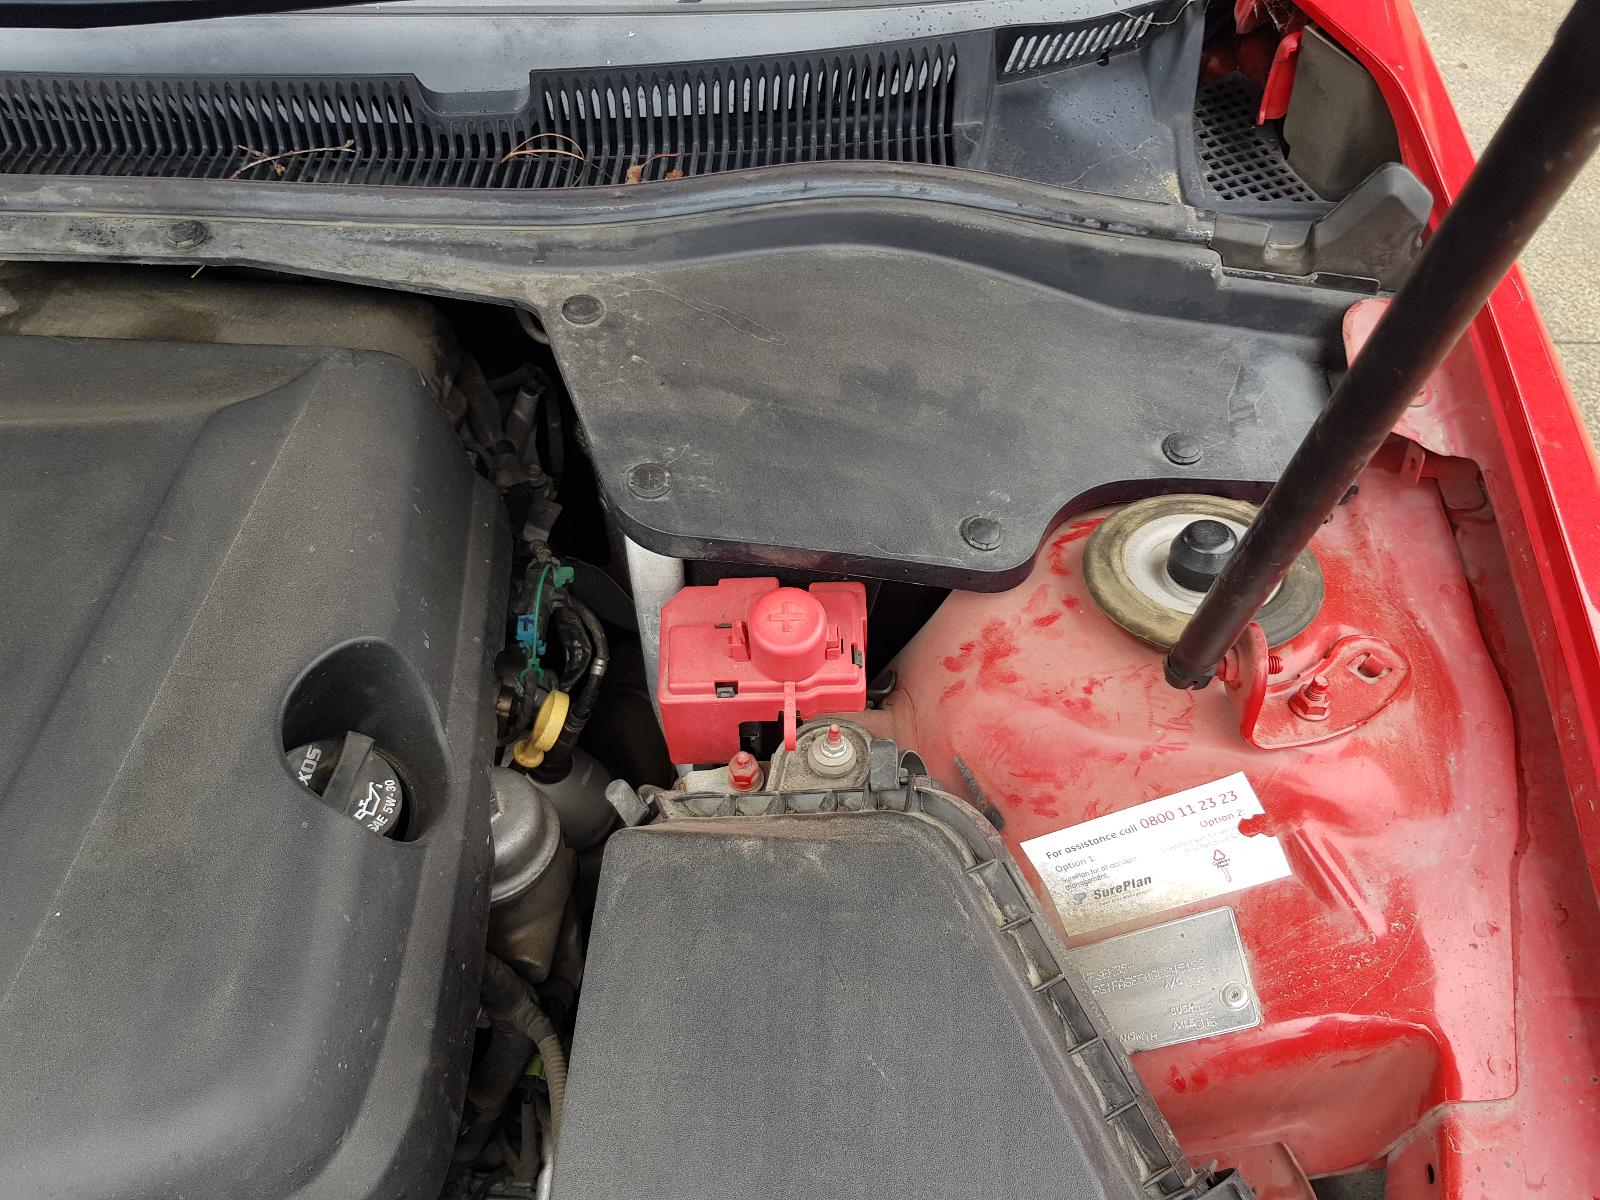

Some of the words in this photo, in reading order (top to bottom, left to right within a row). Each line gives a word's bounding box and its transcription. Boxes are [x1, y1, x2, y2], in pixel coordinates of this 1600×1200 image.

[383, 779, 397, 814] 5W-30
[1045, 849, 1063, 860] For
[1064, 832, 1118, 854] assistance
[1119, 824, 1138, 836] call
[1139, 811, 1175, 830] 0800
[1177, 804, 1197, 818] 11
[1198, 797, 1217, 811] 23
[1219, 790, 1238, 805] 23
[1199, 813, 1235, 828] Option
[1055, 858, 1087, 873] Option
[1093, 876, 1152, 900] SurePlan
